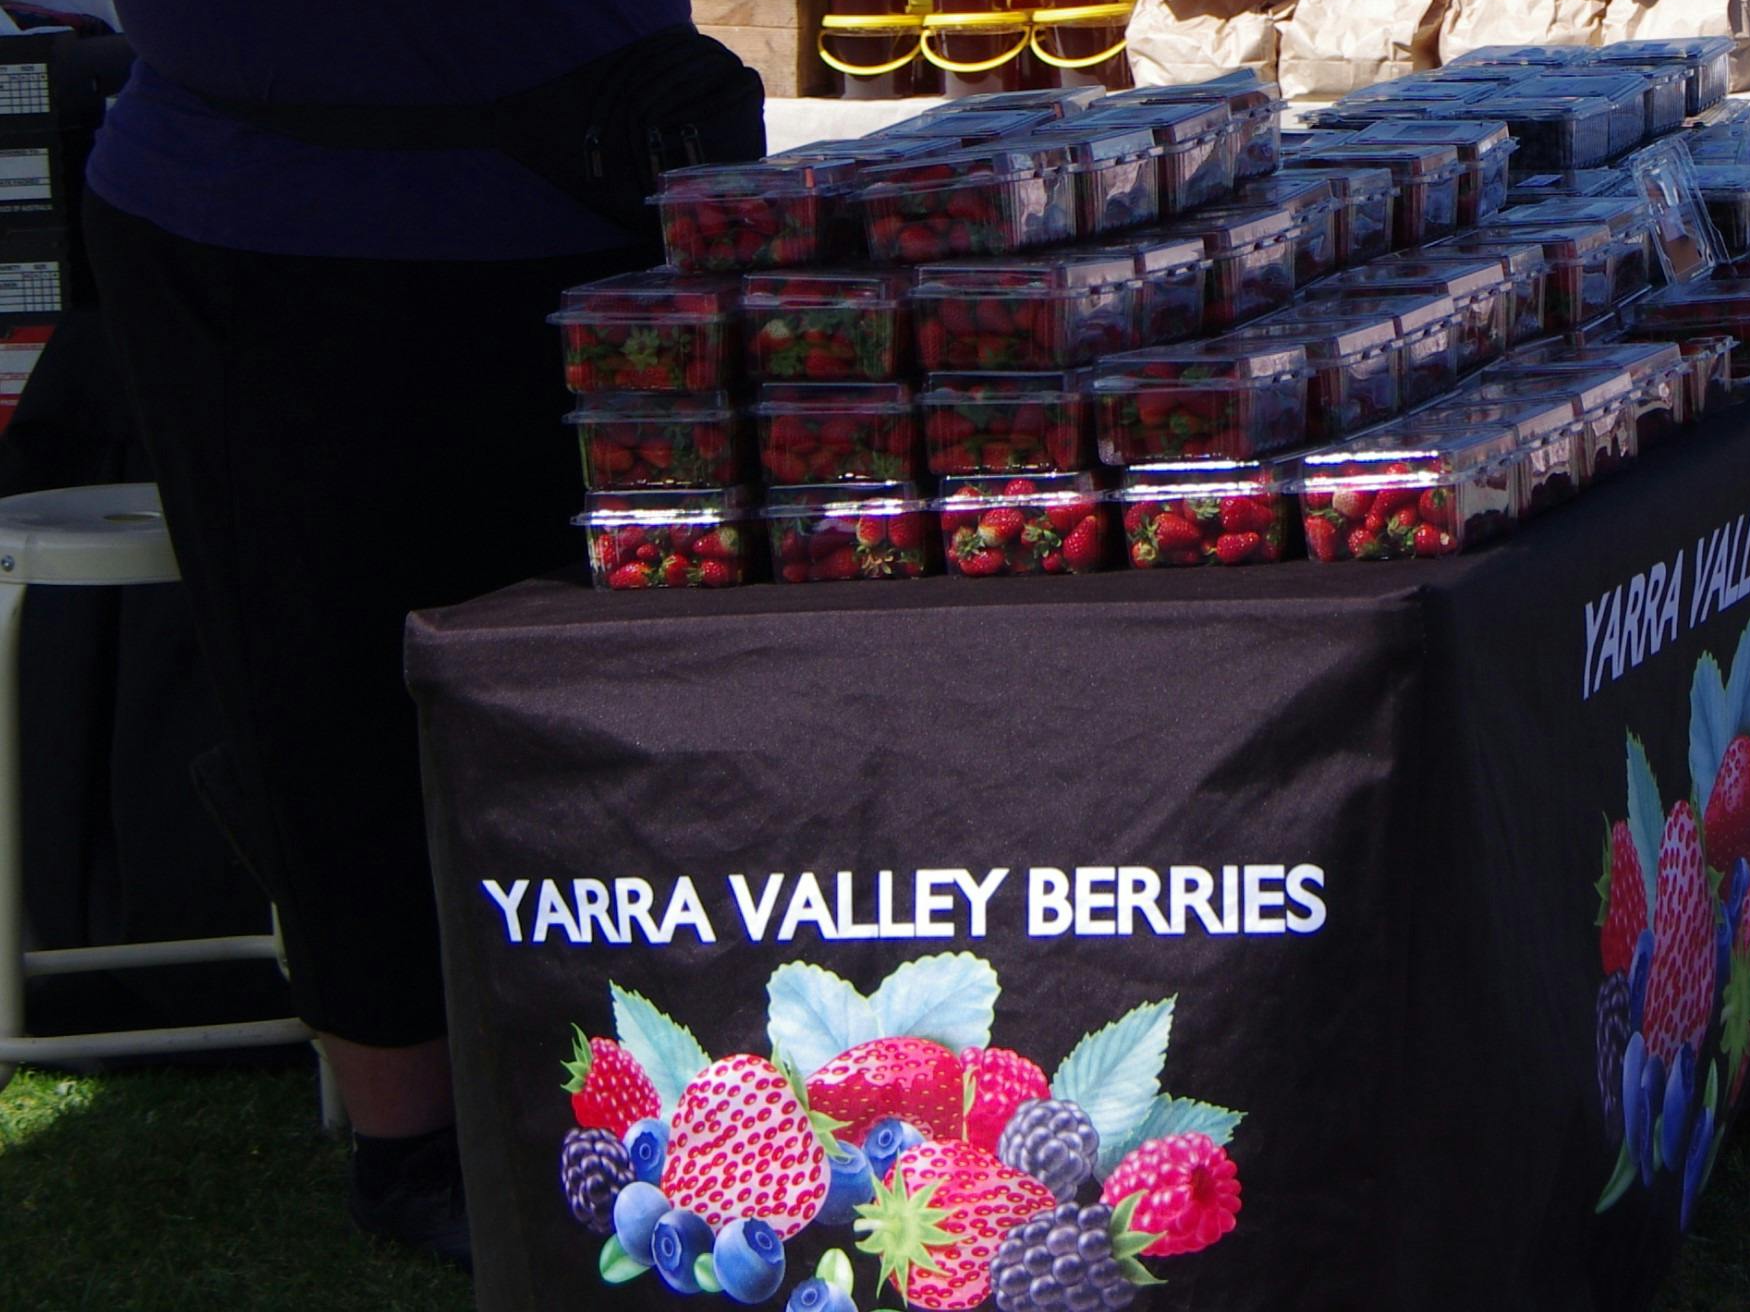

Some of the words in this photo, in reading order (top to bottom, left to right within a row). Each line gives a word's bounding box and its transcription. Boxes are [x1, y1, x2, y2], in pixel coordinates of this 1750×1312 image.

[1582, 549, 1684, 700] YARRA
[483, 877, 717, 945] YARRA
[728, 867, 1010, 943] VALLEY
[1027, 863, 1328, 937] BERRIES
